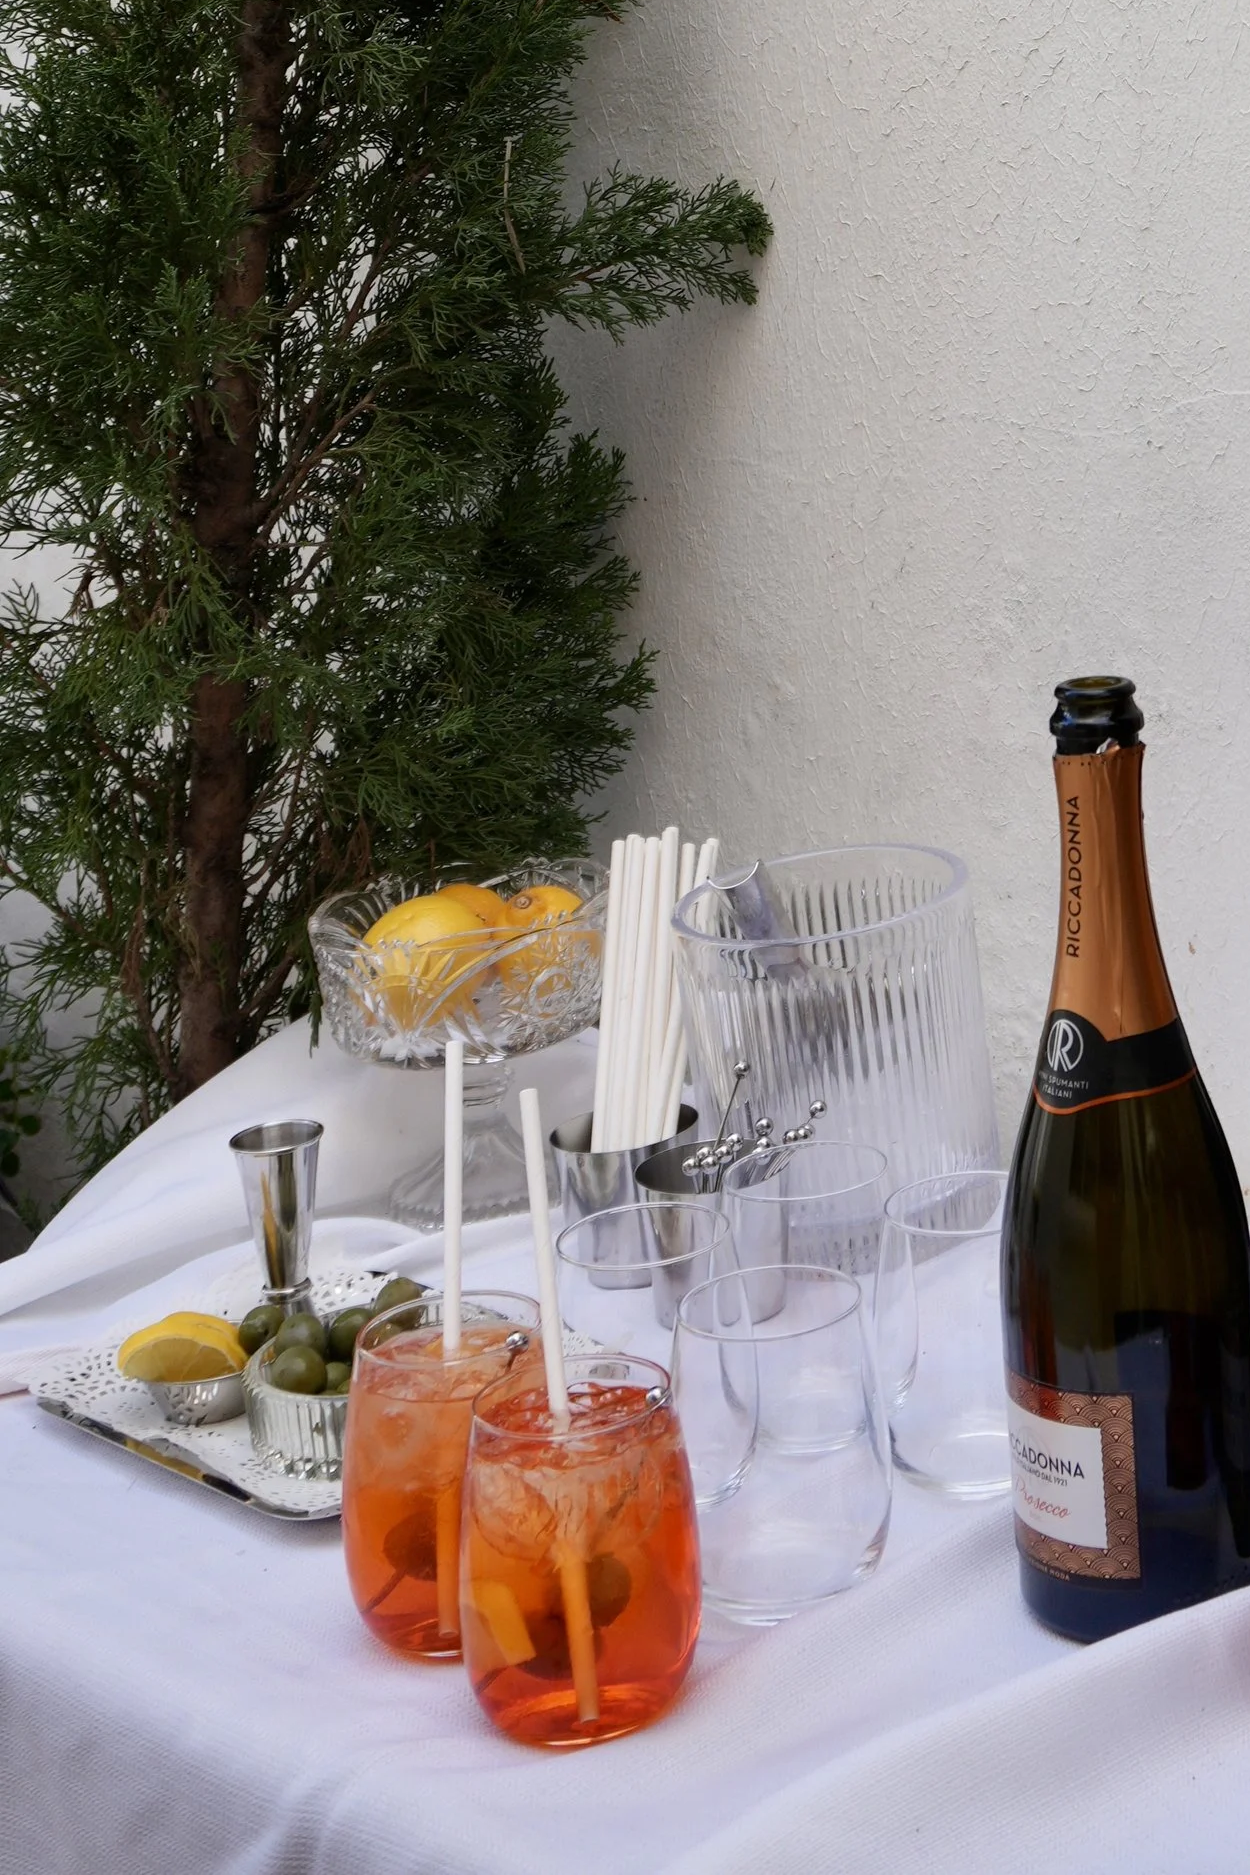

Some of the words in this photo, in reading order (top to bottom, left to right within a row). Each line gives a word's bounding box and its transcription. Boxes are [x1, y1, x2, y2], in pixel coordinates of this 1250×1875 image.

[1066, 795, 1083, 958] RICCADONNA
[1042, 1085, 1072, 1099] ITALIANI
[1048, 1074, 1089, 1090] SPUMANTI
[1015, 1475, 1072, 1519] Prosecco
